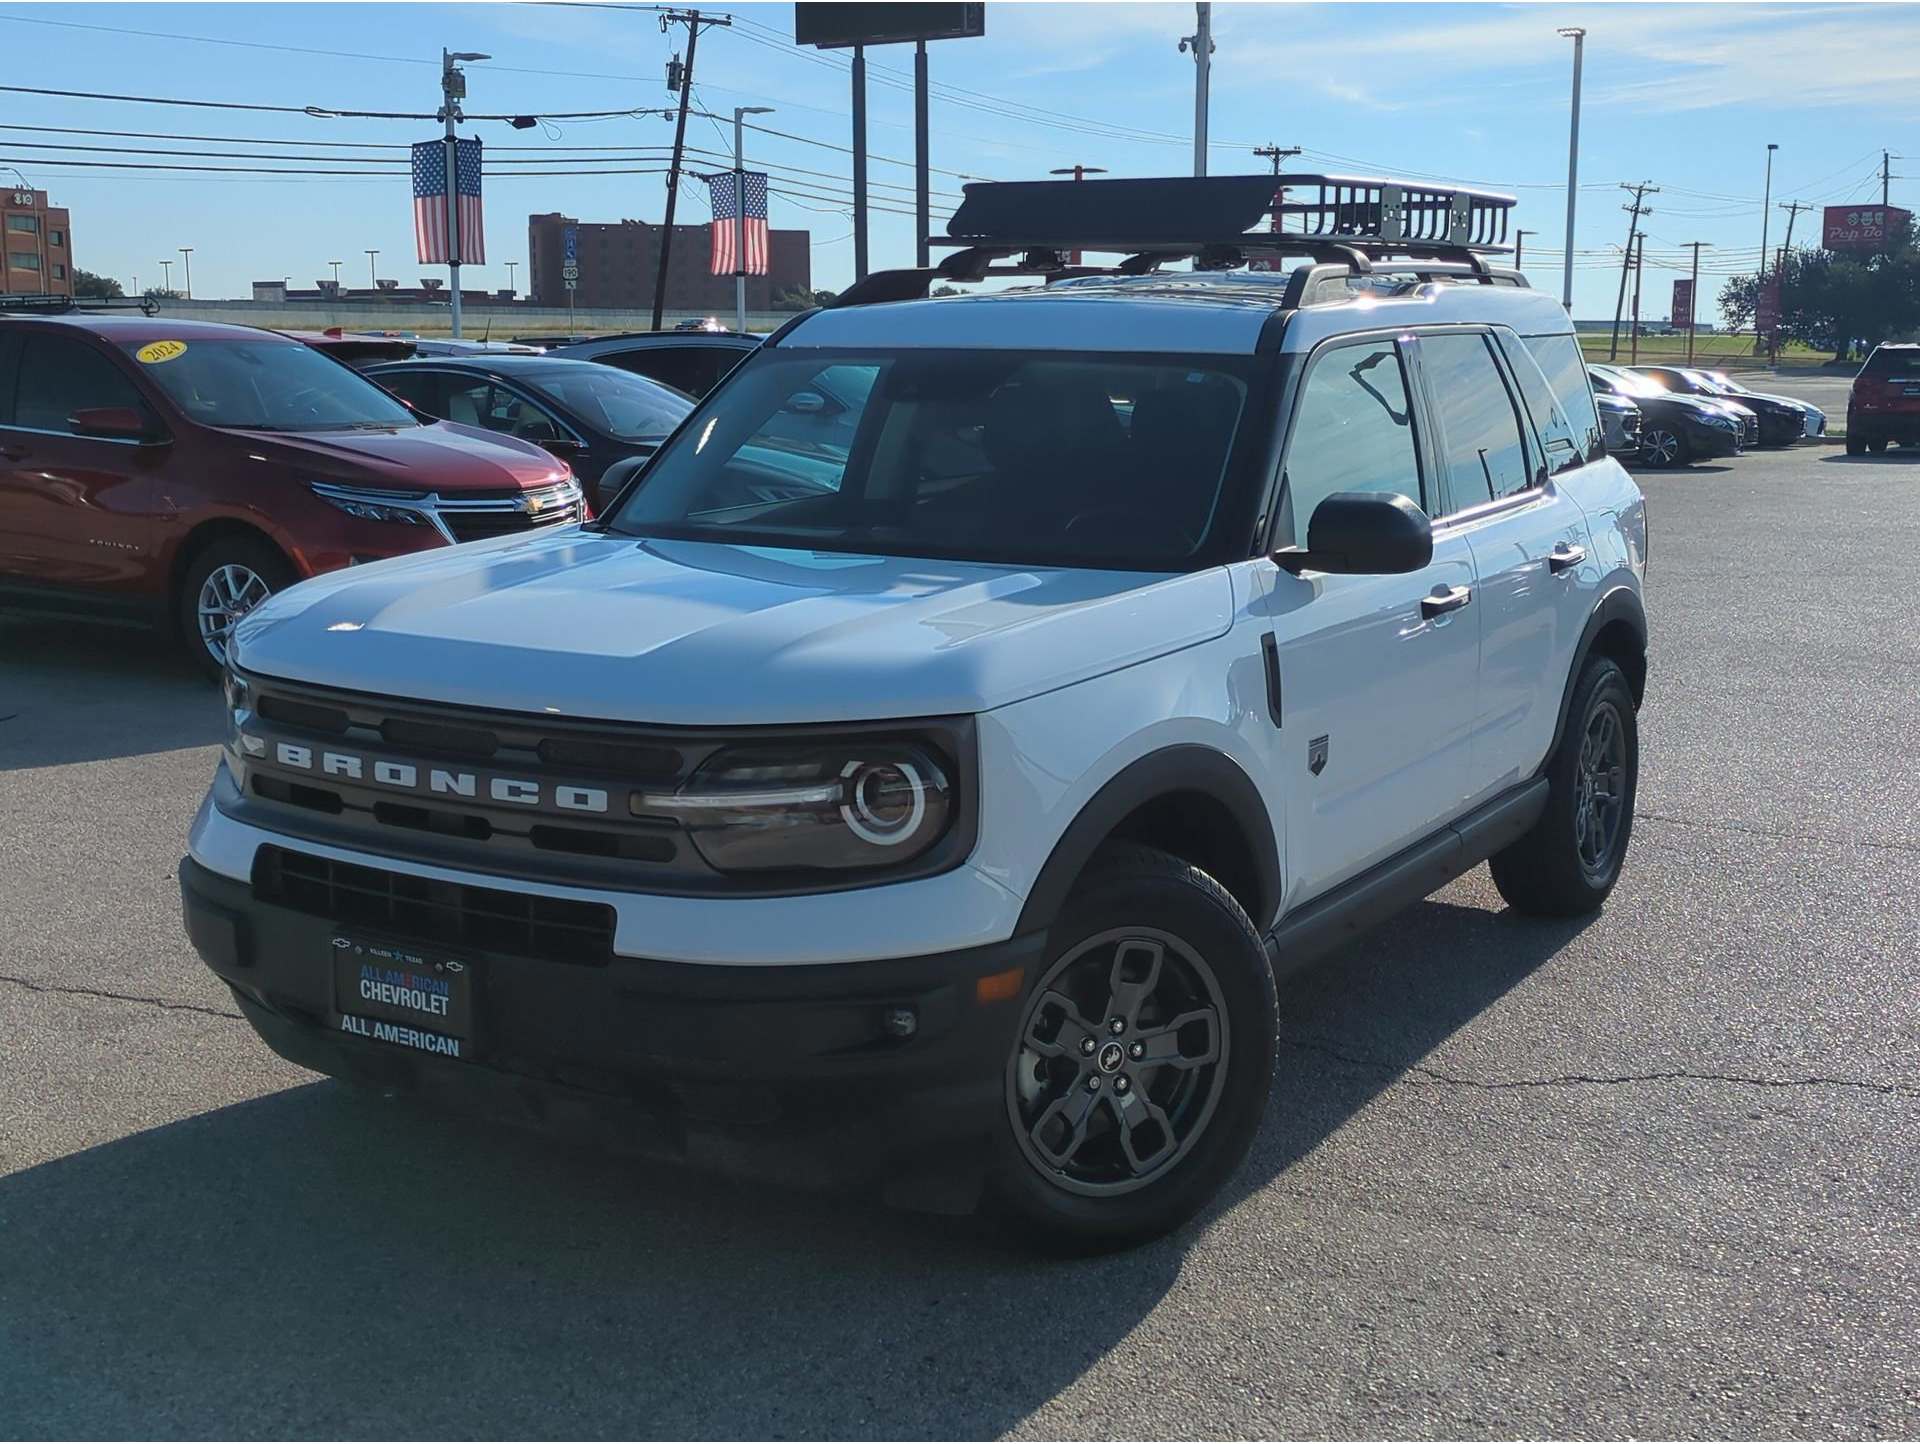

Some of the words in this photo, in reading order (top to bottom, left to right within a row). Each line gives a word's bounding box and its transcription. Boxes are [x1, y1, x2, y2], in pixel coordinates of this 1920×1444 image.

[1862, 226, 1883, 238] Bo
[144, 342, 180, 361] 2024
[276, 742, 608, 813] BRONCO
[360, 964, 382, 982] ALL
[385, 968, 449, 996] AMERICAN
[360, 979, 449, 1016] CHEVROLET
[341, 1014, 370, 1036] ALL
[374, 1022, 460, 1057] AMERICAN
